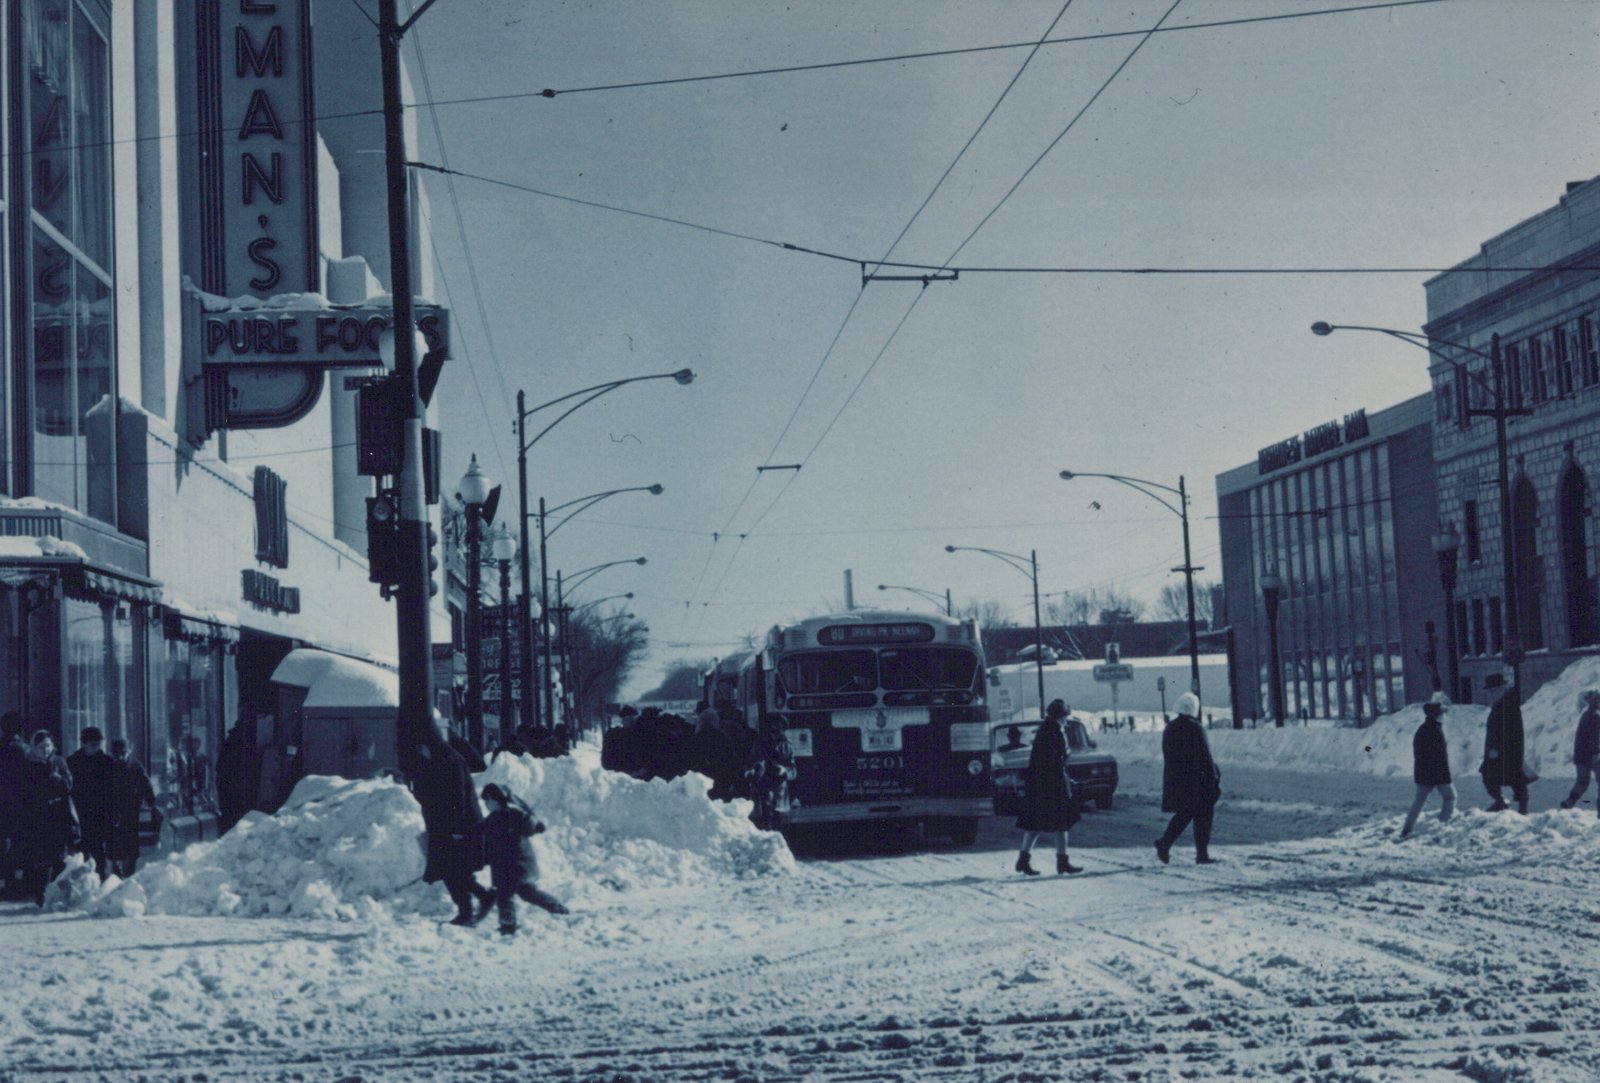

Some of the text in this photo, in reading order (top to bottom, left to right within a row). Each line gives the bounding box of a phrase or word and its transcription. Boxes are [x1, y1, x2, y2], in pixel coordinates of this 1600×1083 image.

[207, 316, 441, 357] PURE FOOS
[856, 756, 905, 770] 5201
